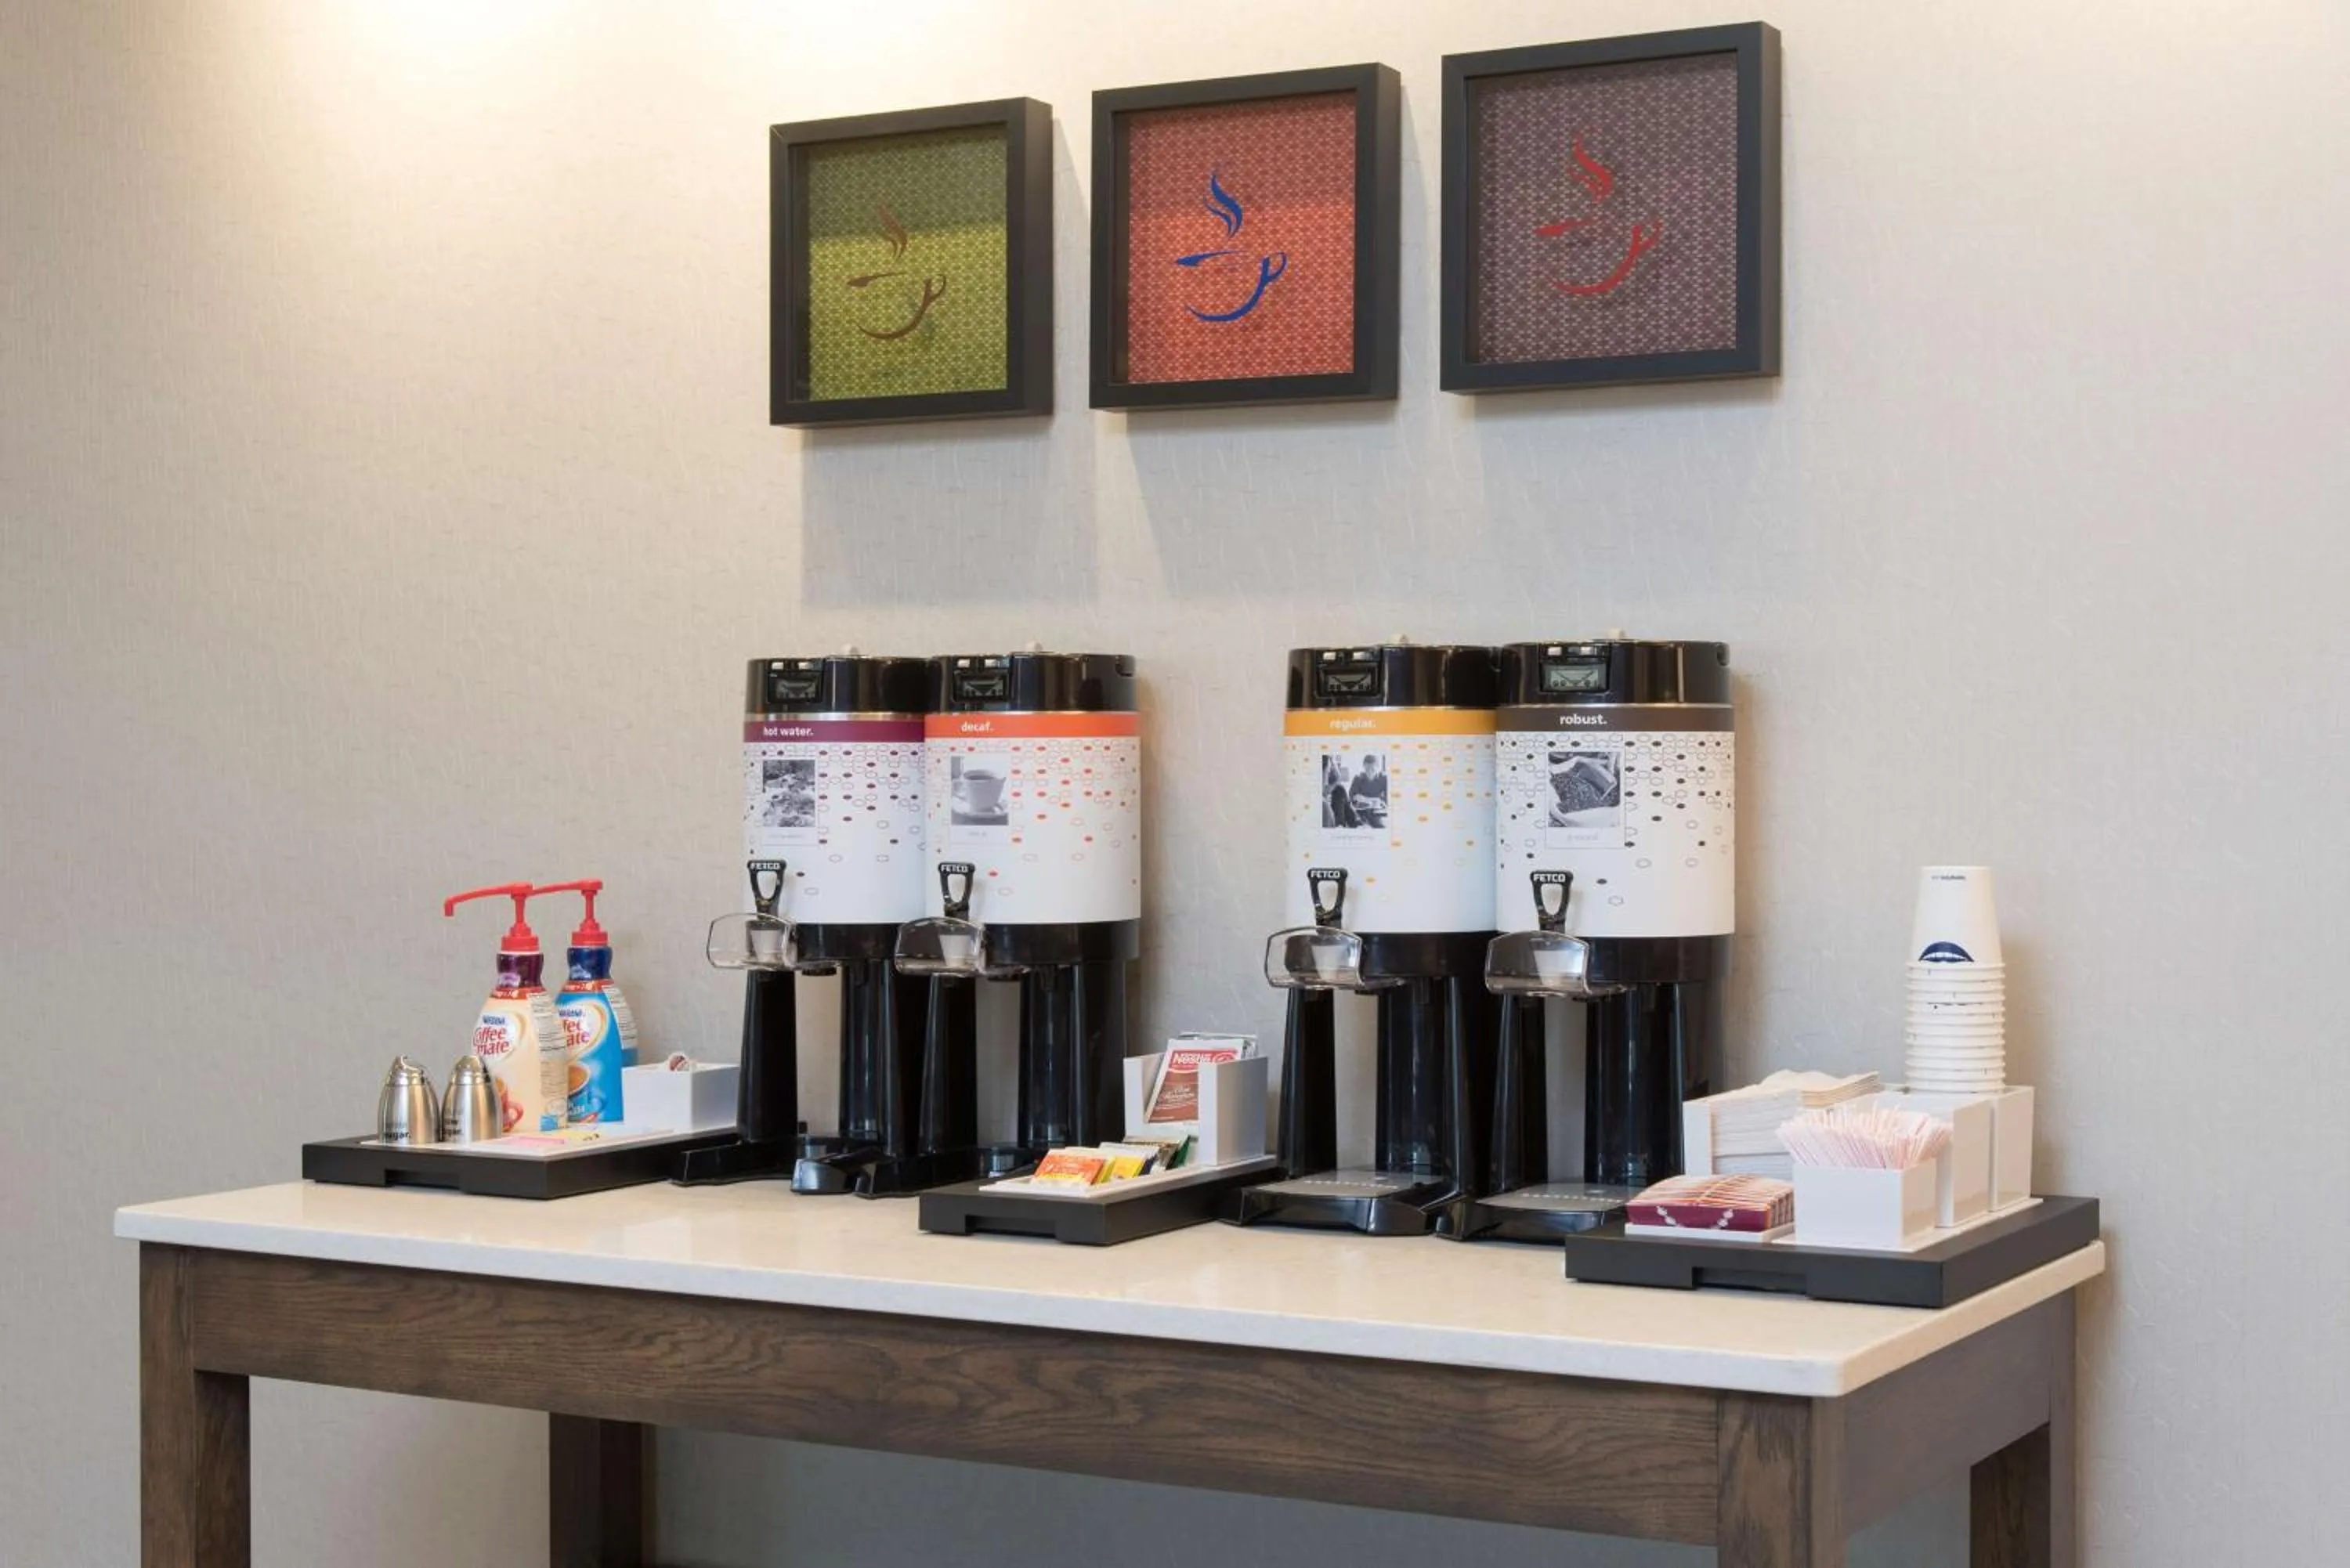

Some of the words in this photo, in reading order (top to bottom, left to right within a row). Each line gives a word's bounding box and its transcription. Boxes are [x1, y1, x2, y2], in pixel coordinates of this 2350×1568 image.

[1559, 713, 1608, 725] robust.
[764, 725, 778, 737] hot
[779, 726, 814, 737] water.
[941, 864, 969, 873] FETCO
[1311, 869, 1340, 879] FETCO
[1533, 873, 1566, 883] FETCO
[472, 1025, 507, 1047] Coffee
[565, 1031, 591, 1047] ate
[475, 1040, 510, 1056] mate
